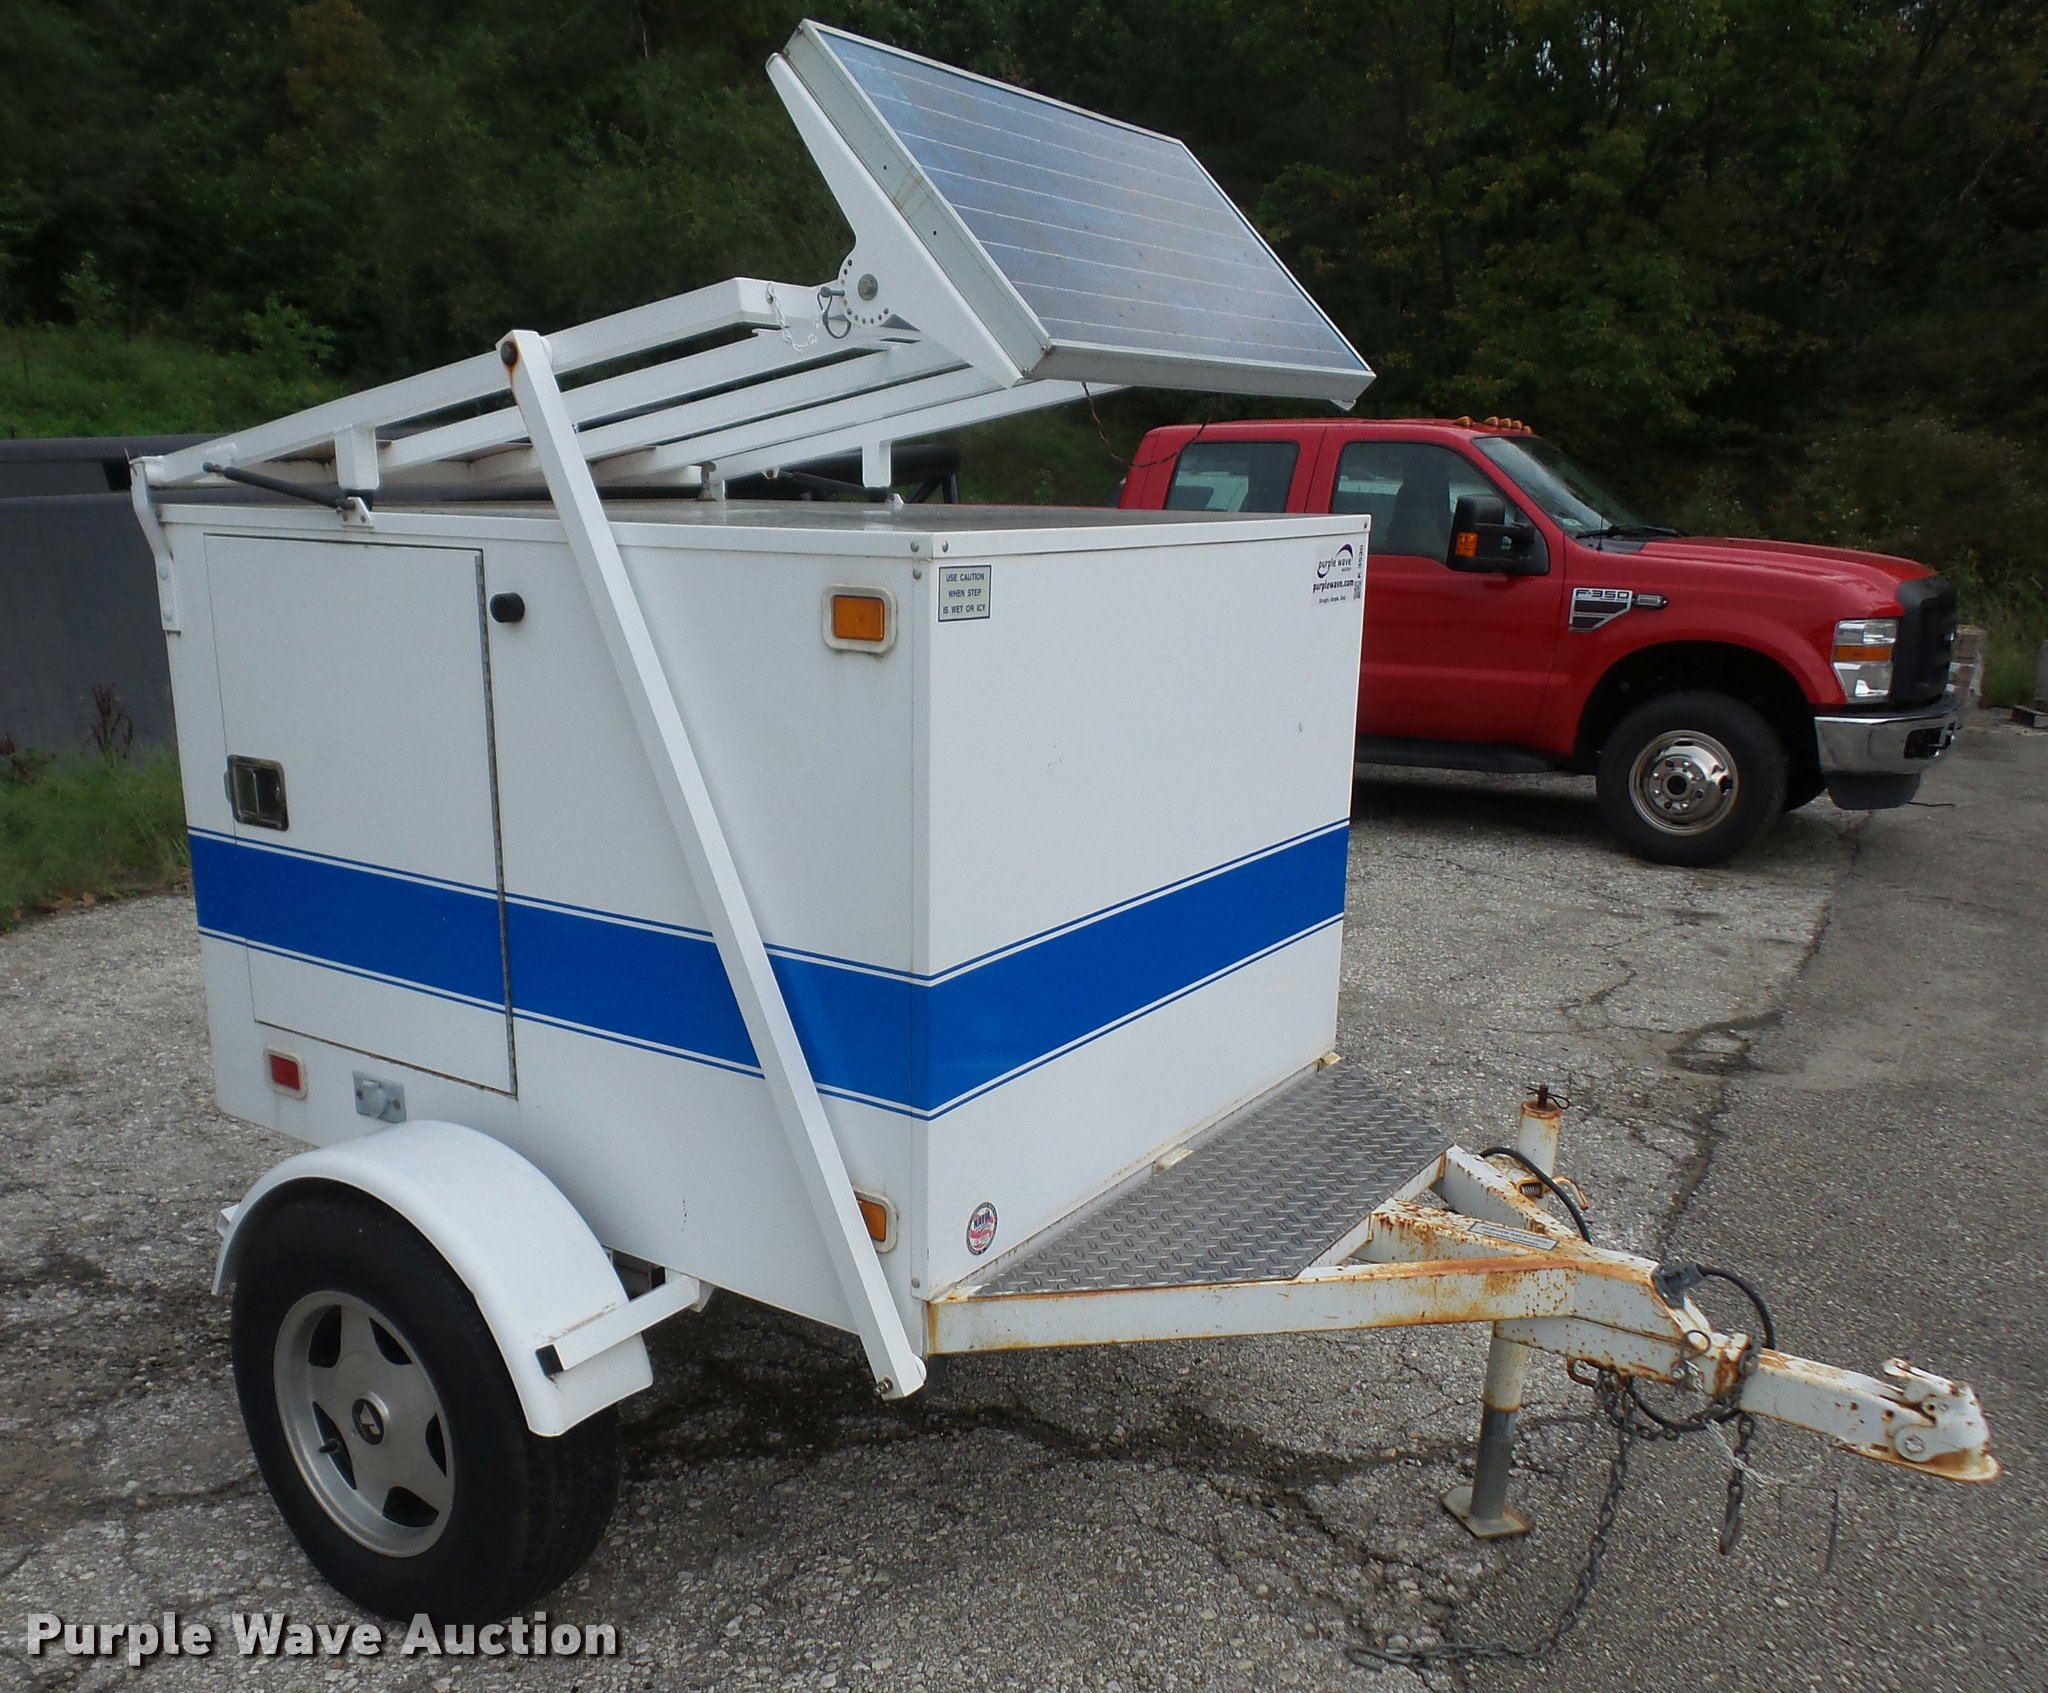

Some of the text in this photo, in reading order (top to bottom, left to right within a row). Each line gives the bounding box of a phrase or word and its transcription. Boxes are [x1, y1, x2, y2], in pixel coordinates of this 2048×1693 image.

[946, 572, 984, 582] USE CAUTION
[1313, 579, 1353, 594] purplewave.com
[949, 588, 981, 598] WHEN STEP
[1576, 589, 1629, 599] F-350
[943, 603, 986, 614] IS WET OR ICY
